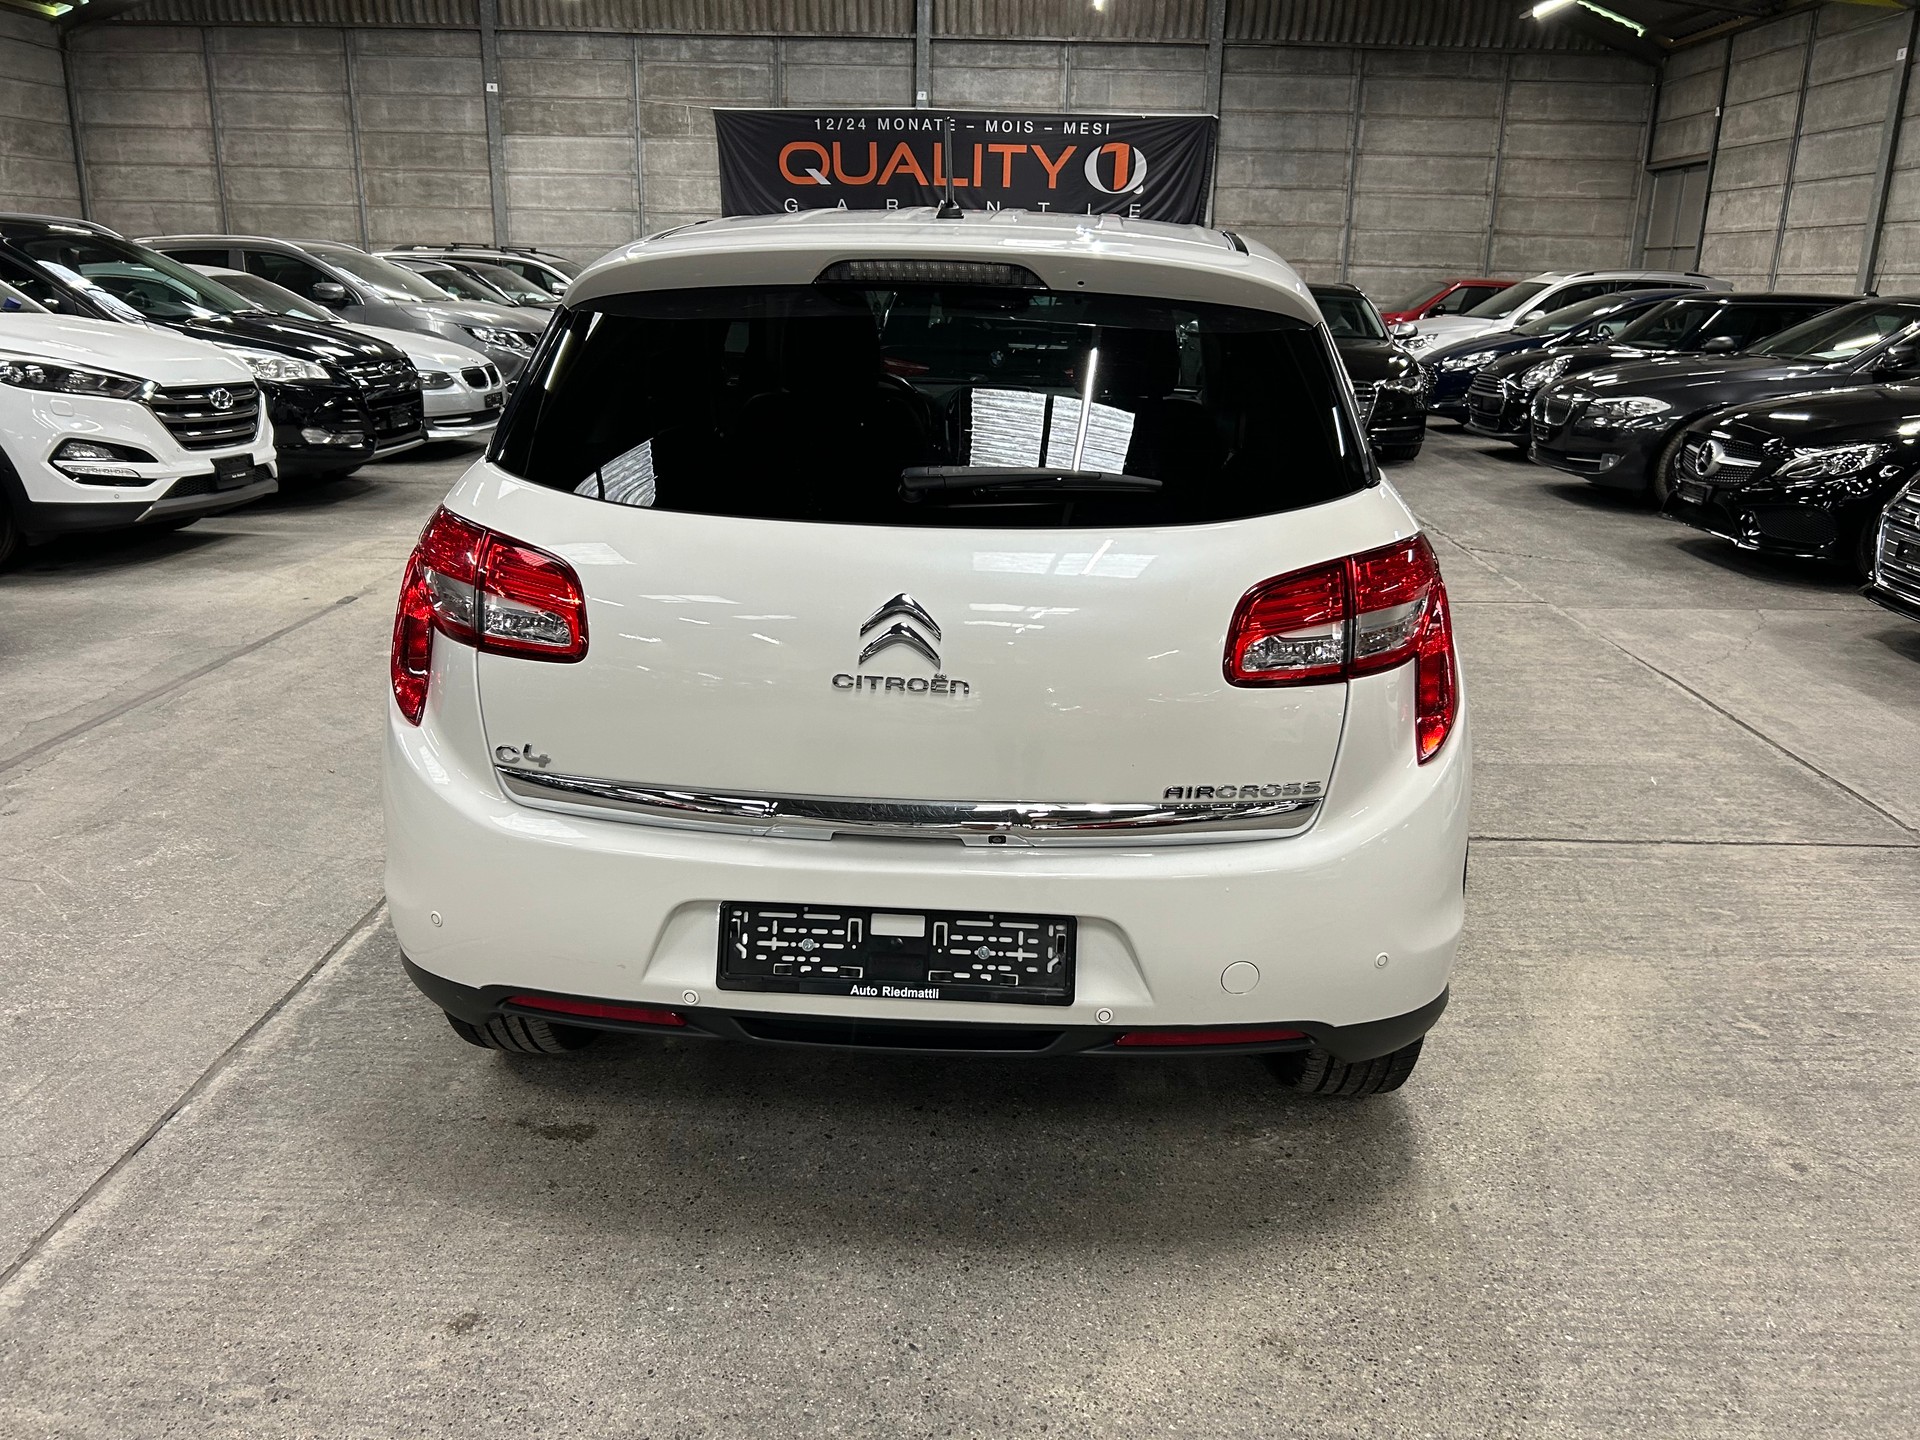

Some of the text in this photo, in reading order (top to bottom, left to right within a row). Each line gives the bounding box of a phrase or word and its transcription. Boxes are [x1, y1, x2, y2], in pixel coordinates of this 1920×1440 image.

[814, 118, 867, 130] 12/24
[877, 118, 956, 131] MONATE
[985, 120, 1034, 133] MOIS
[1063, 122, 1111, 135] MESI
[778, 141, 1078, 189] QUALITY
[784, 198, 1142, 218] GARNTIE
[1163, 778, 1322, 799] AIRCROSS
[850, 984, 940, 999] Auto Riedmattli
